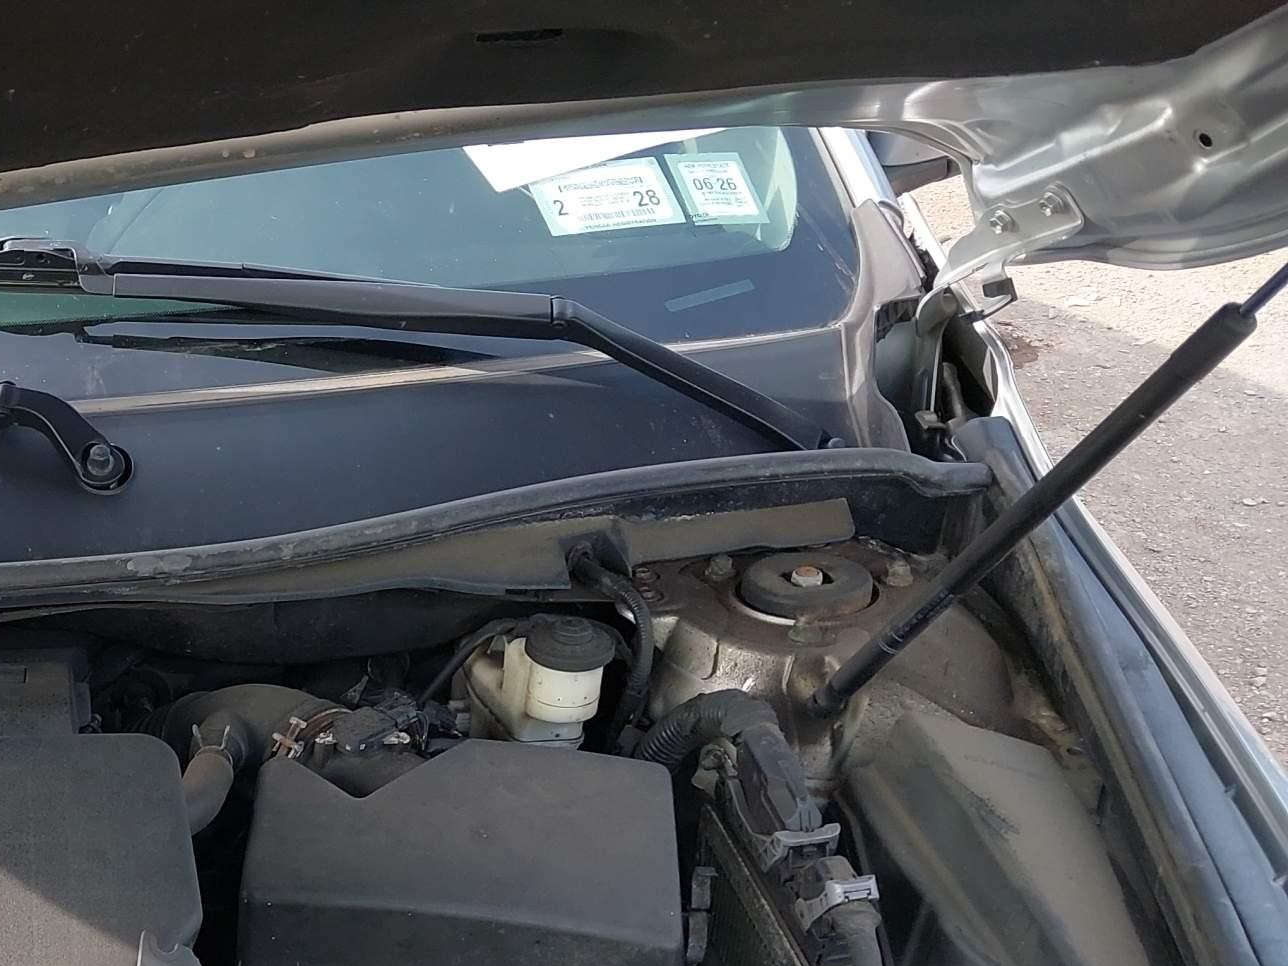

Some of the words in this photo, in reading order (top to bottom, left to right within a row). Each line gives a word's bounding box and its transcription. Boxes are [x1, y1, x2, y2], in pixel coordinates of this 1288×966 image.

[692, 178, 714, 190] 06
[716, 178, 737, 190] 26
[632, 189, 661, 207] 28
[553, 199, 569, 216] 2
